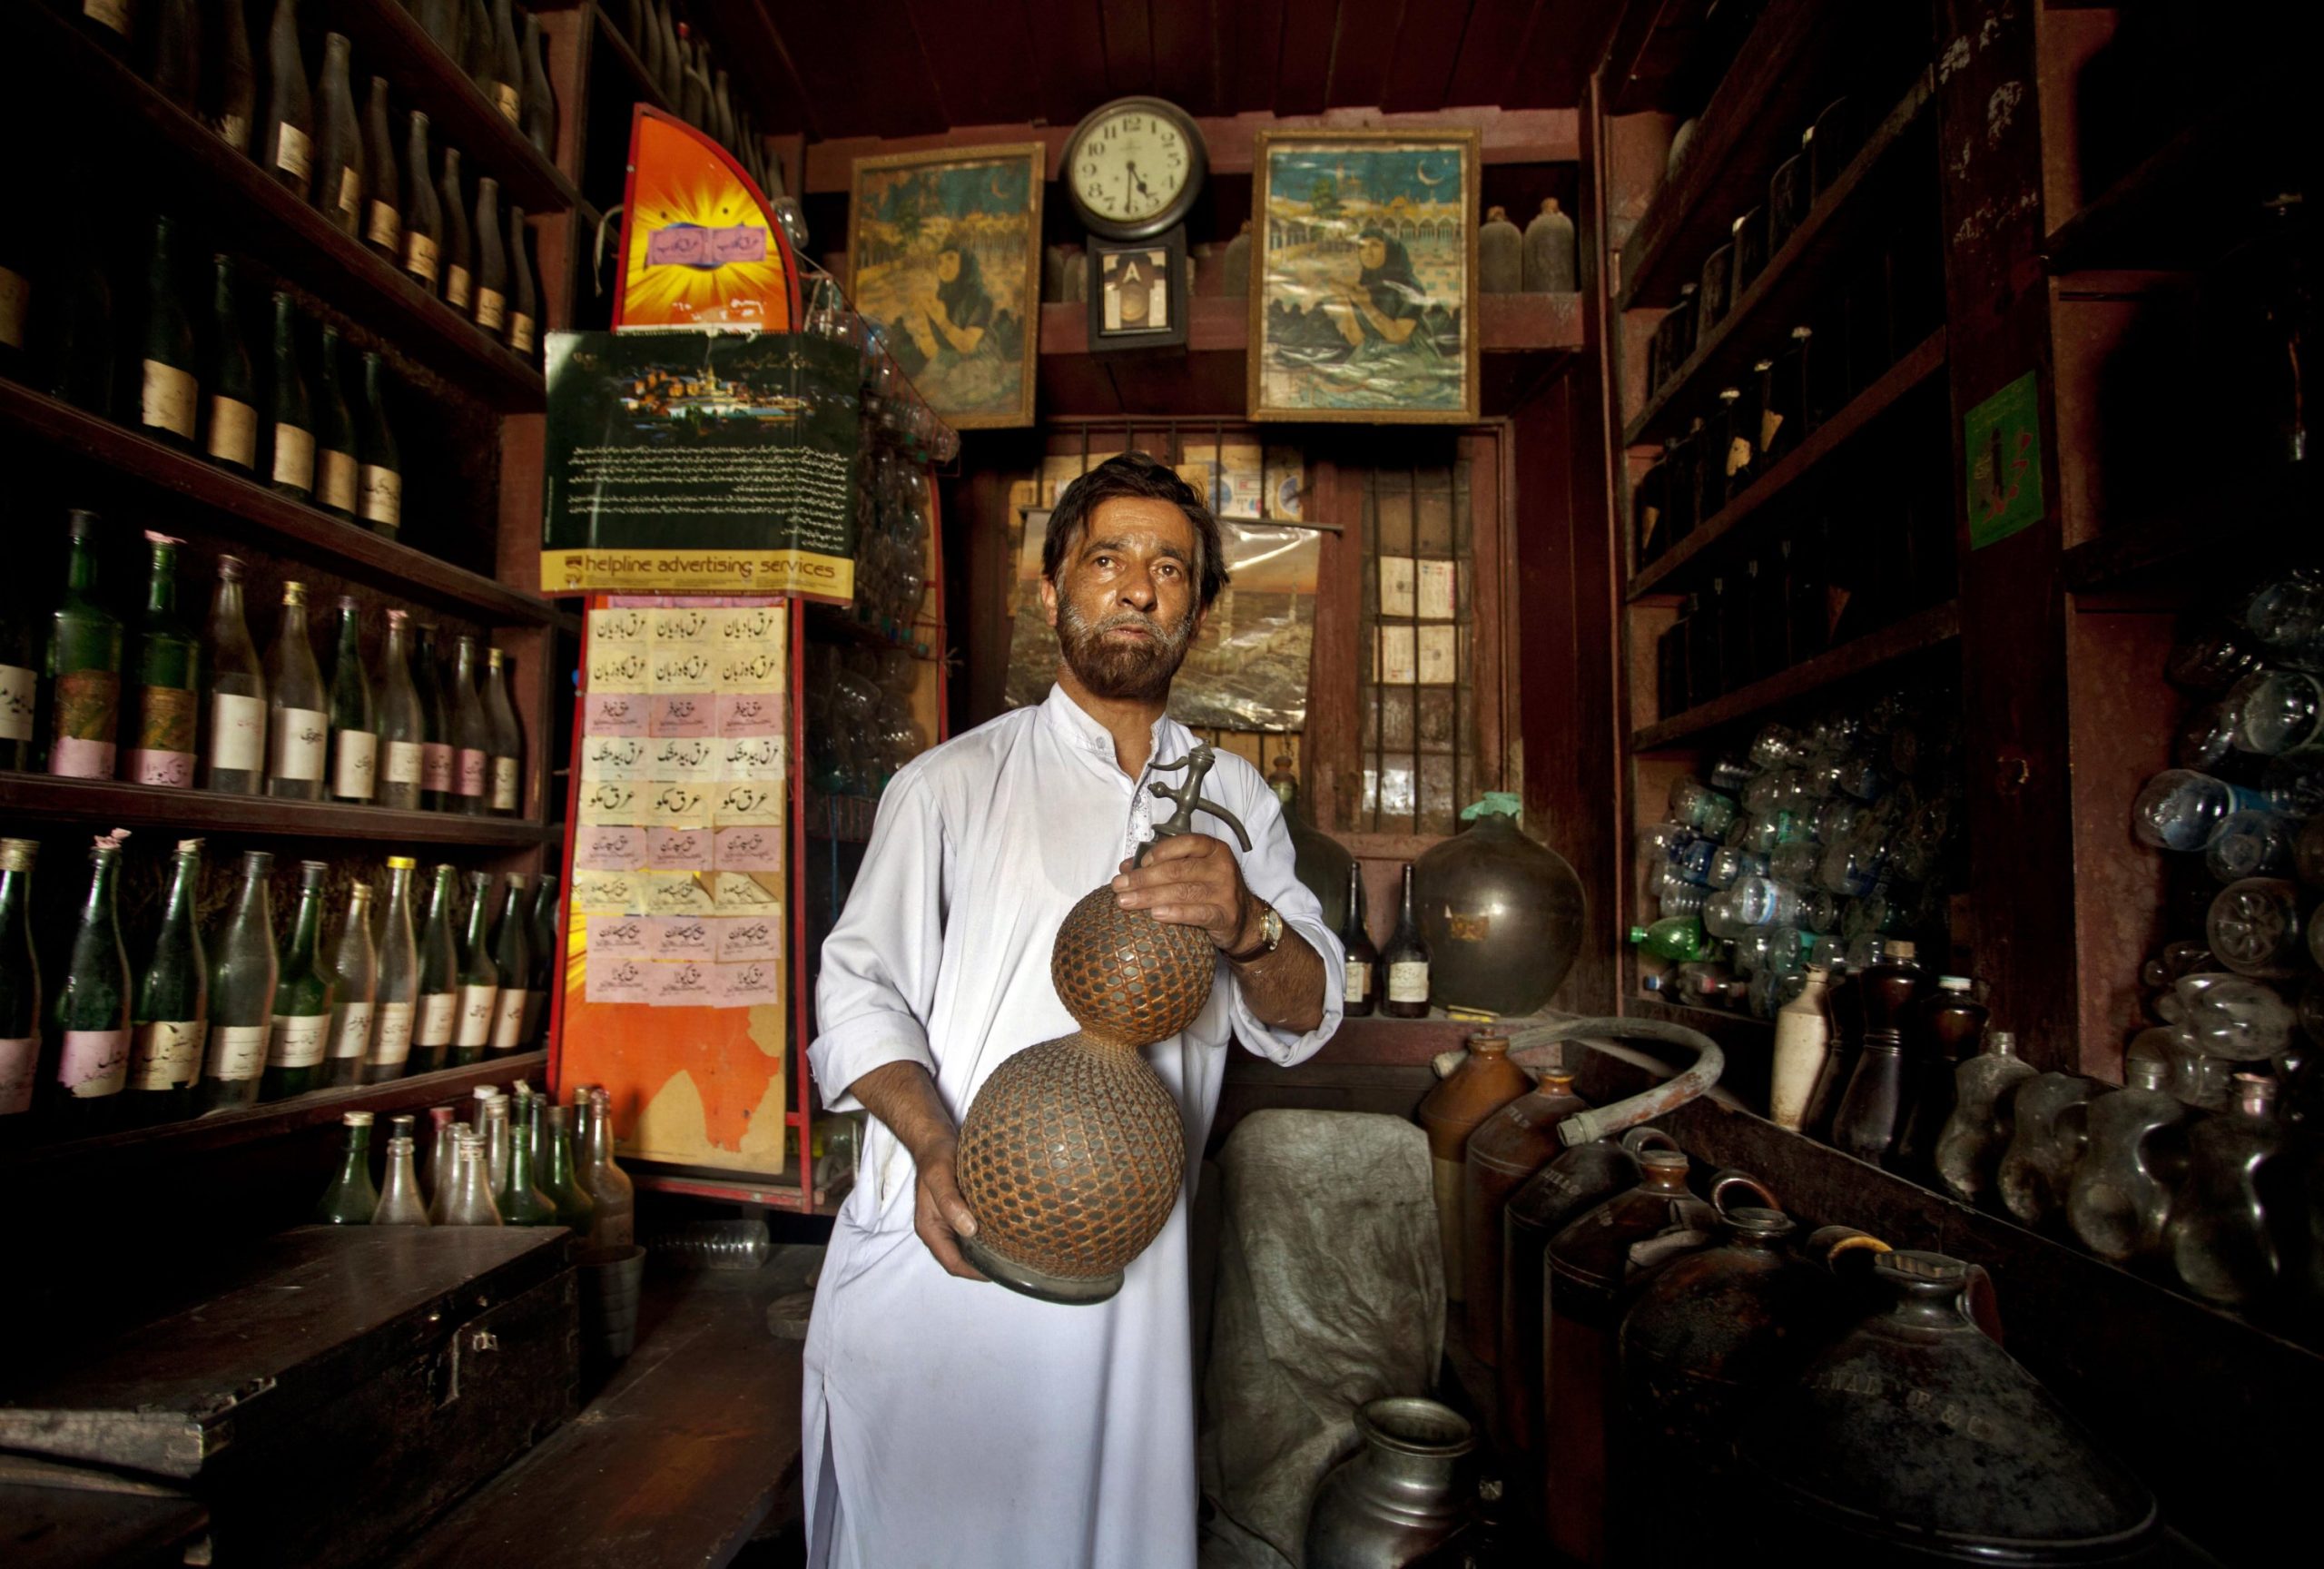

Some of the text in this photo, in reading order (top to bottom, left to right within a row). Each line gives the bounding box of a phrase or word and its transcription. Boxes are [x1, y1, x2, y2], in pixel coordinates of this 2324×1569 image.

[586, 555, 835, 578] helpline advertising services
[626, 613, 646, 636] عرق
[686, 612, 707, 636] عرق
[753, 612, 774, 636] عرق
[626, 656, 646, 679] عرق
[689, 655, 708, 679] عرق
[755, 655, 775, 679] عرق
[624, 742, 644, 765] عرق
[690, 742, 710, 765] عرق
[760, 741, 778, 765] عرق
[603, 787, 635, 809] عرق
[669, 791, 702, 812] عرق
[736, 790, 767, 811] عرق
